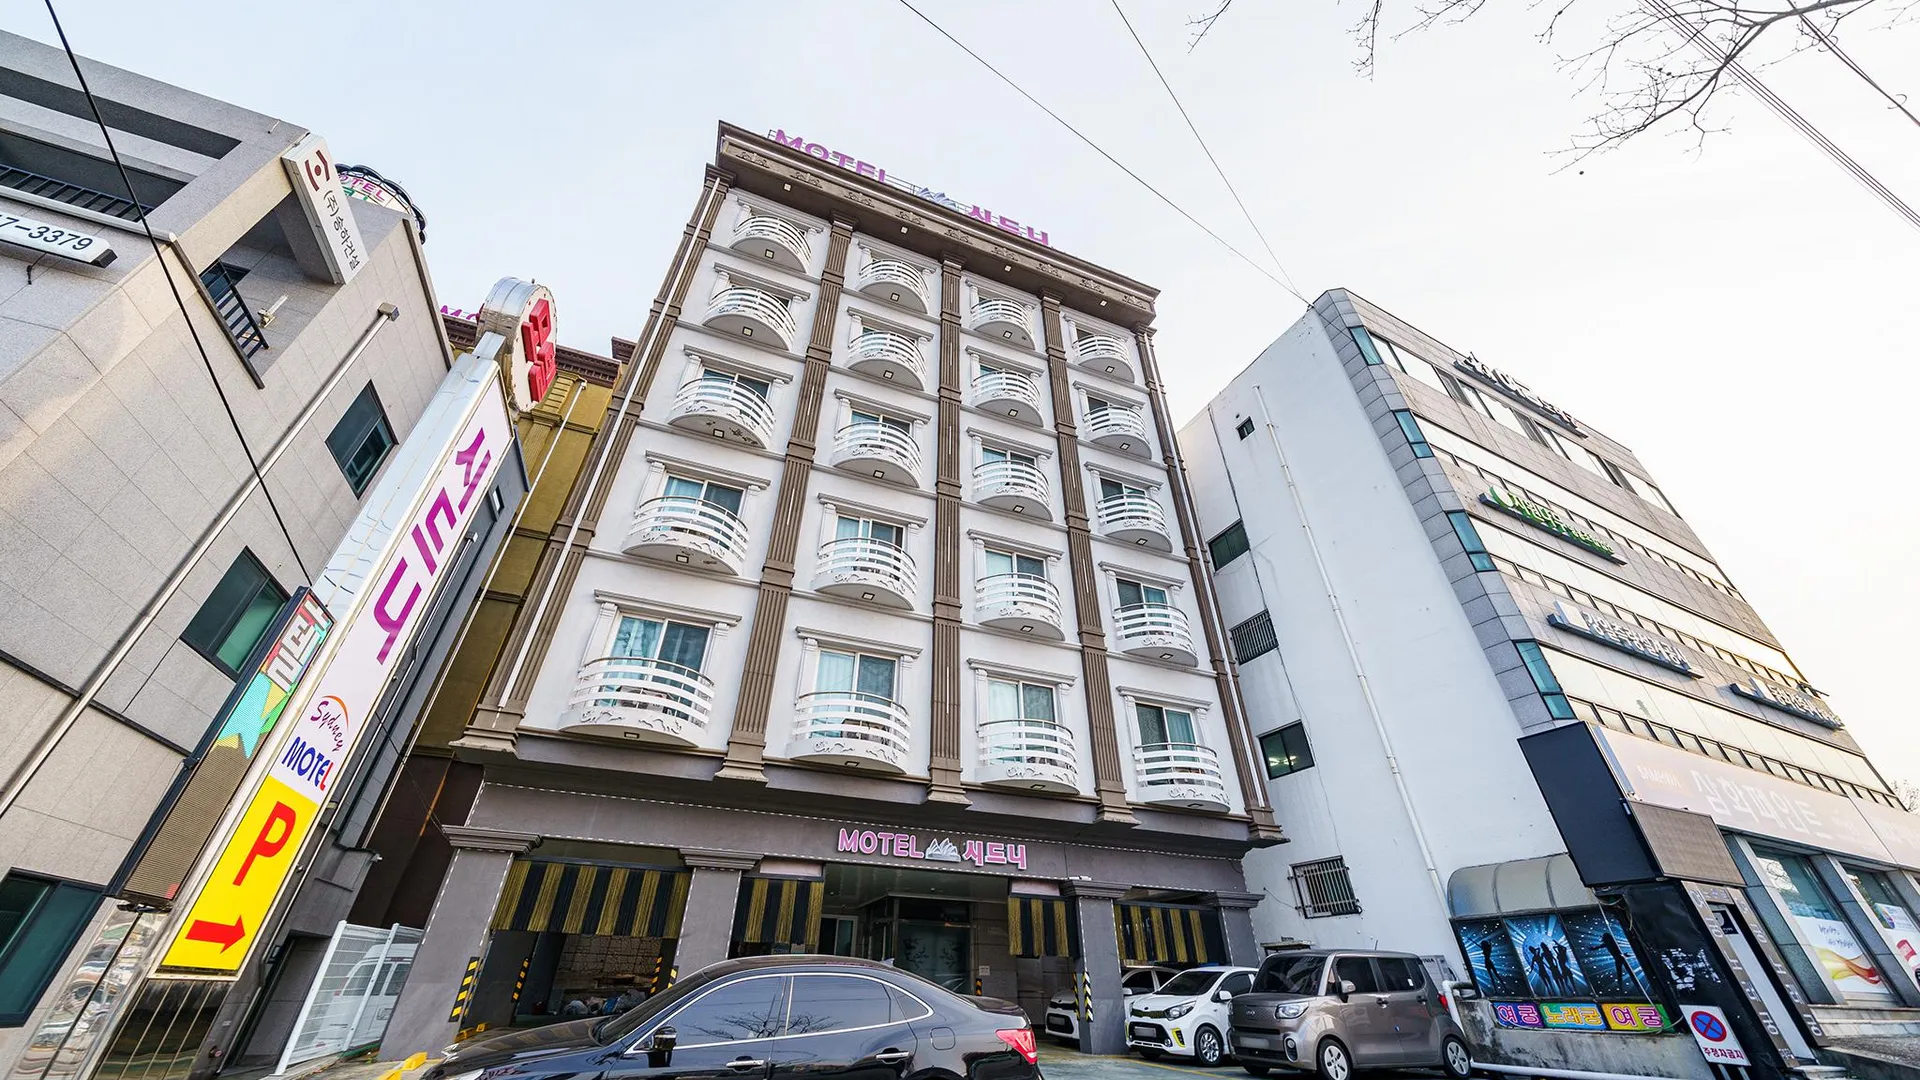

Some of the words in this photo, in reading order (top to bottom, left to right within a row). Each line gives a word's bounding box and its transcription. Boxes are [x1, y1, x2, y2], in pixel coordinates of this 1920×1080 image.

[373, 427, 491, 665] 시드니
[310, 701, 343, 751] Sydney
[281, 737, 334, 791] MOTEL
[1690, 769, 1823, 837] 삼화페인트
[233, 801, 296, 886] P
[838, 828, 925, 859] MOTEL
[962, 840, 1027, 870] 시드니
[1543, 1005, 1601, 1026] 노래궁
[1703, 1046, 1745, 1060] 주정차금지
